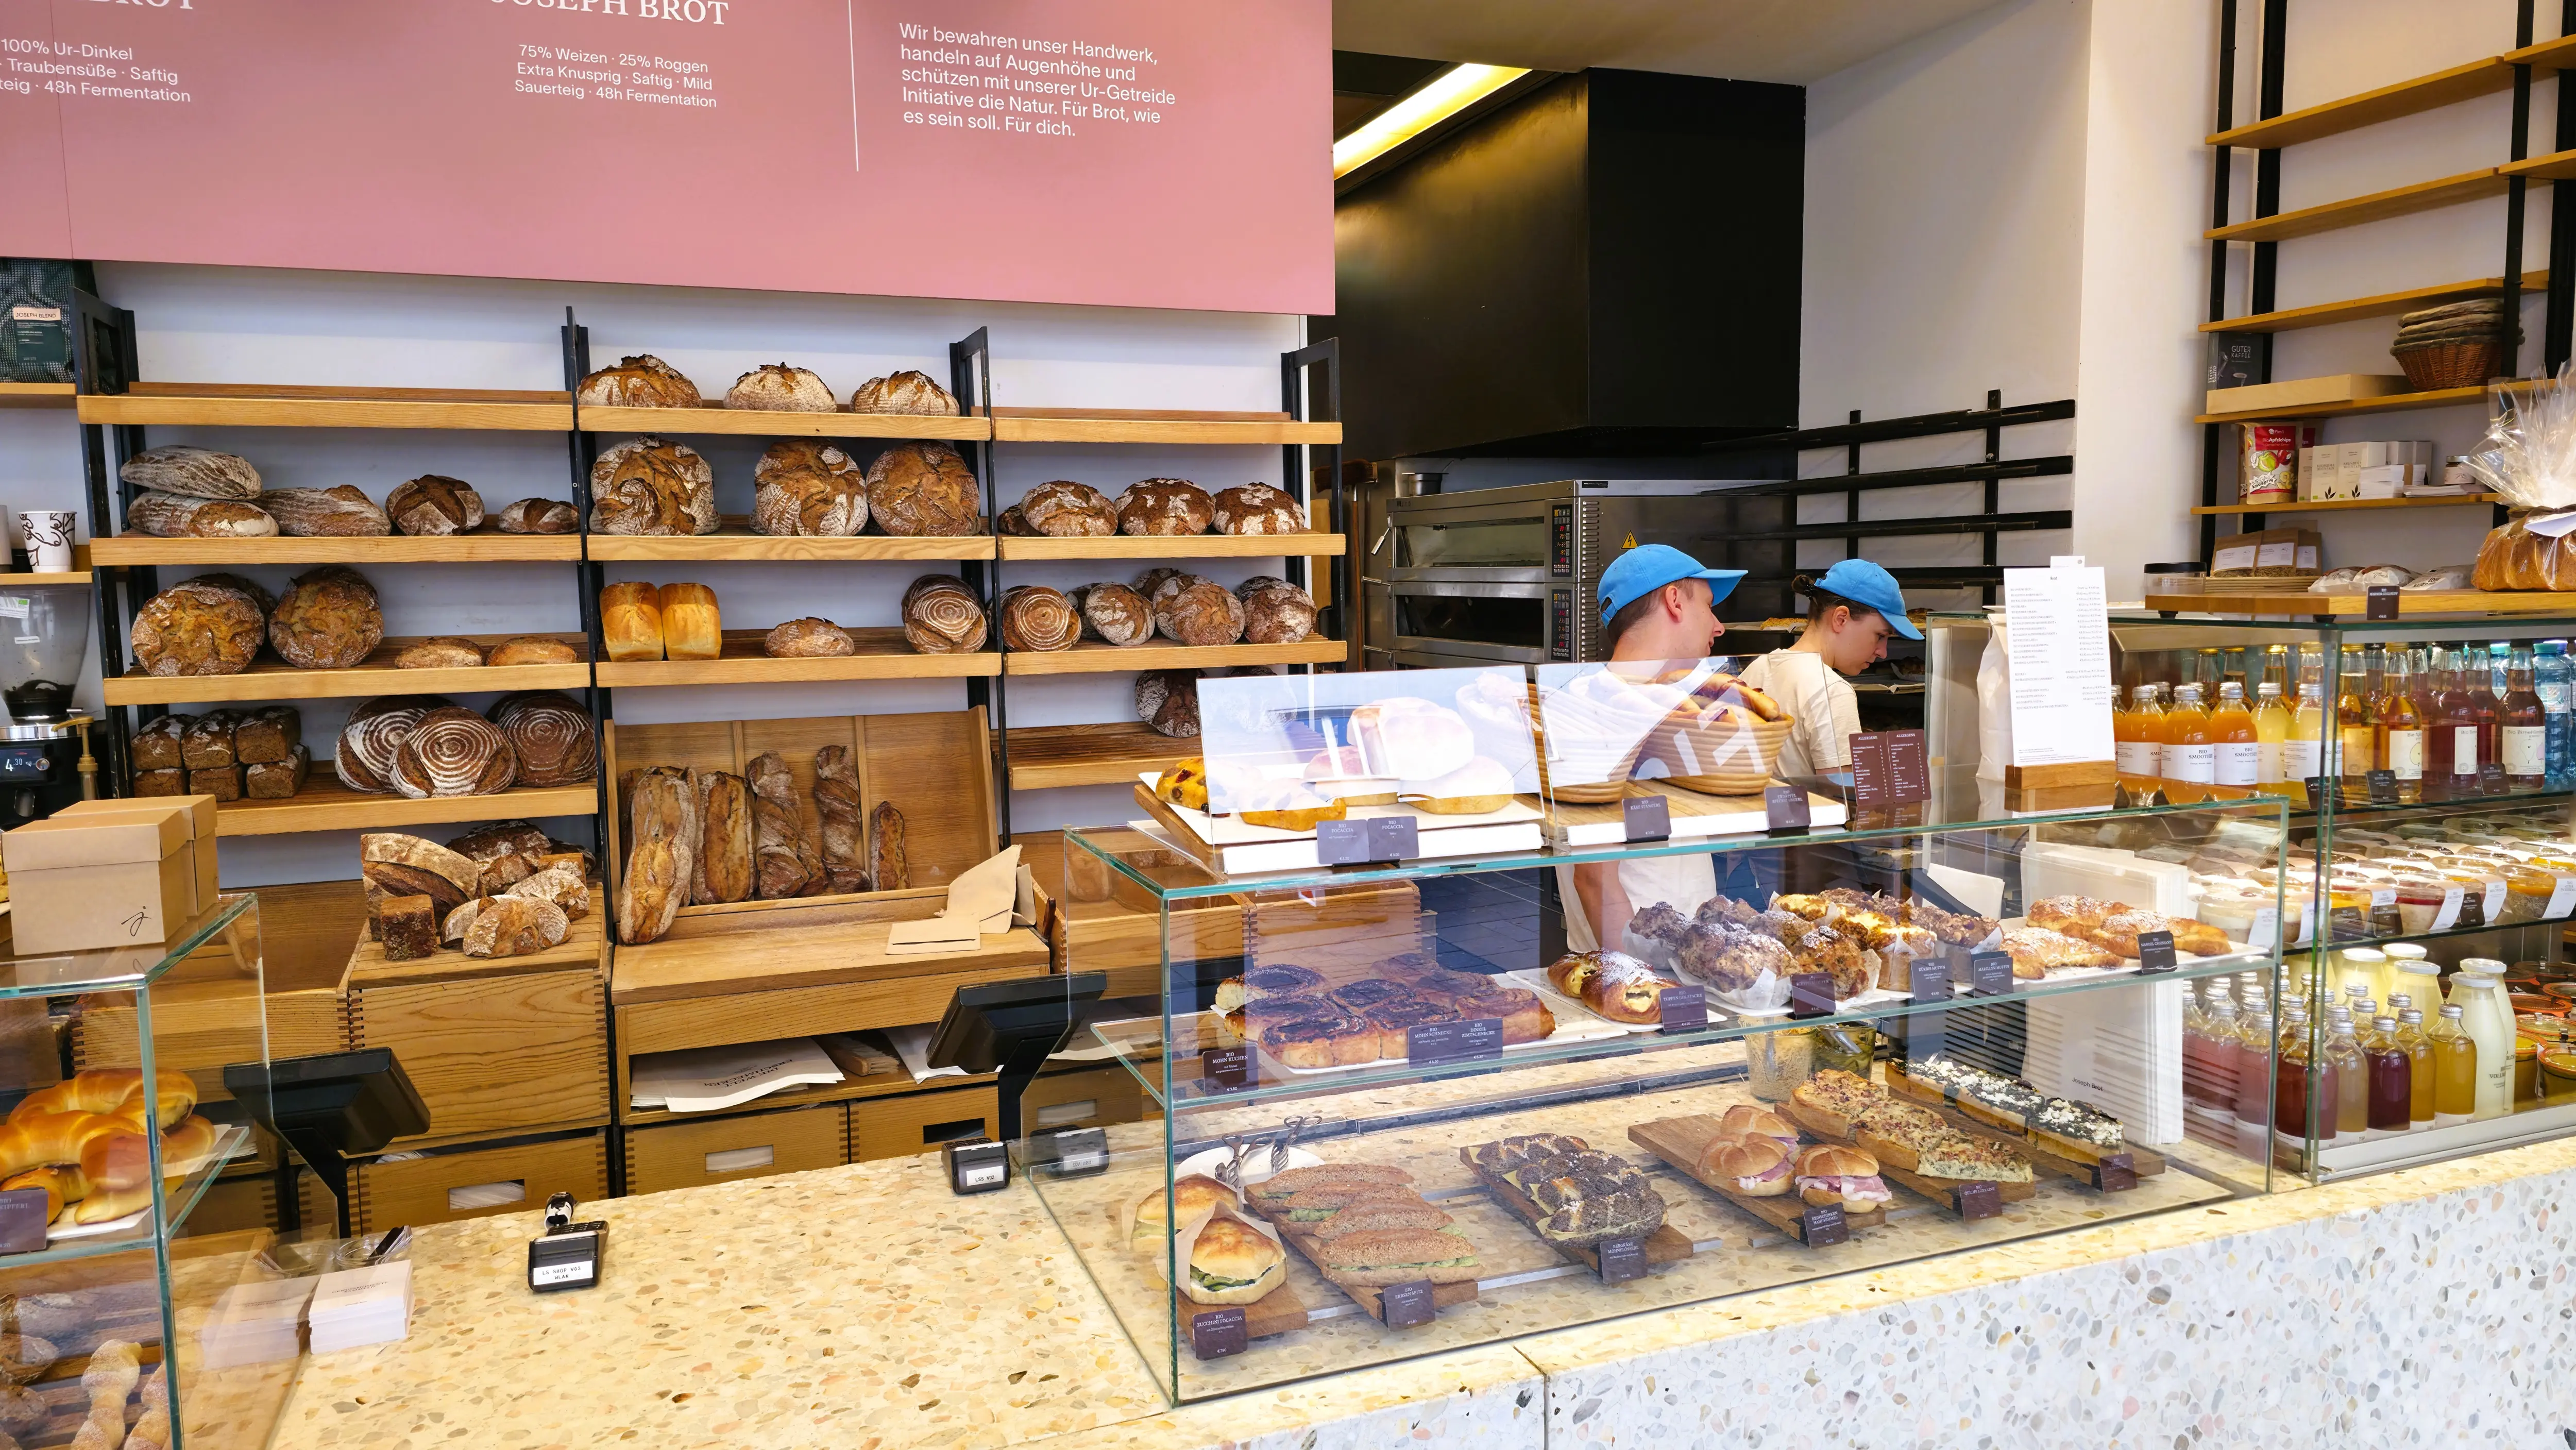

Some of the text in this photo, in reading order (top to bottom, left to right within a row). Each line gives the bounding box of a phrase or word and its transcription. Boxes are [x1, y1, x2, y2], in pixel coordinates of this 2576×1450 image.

[639, 0, 728, 25] BROT
[1, 39, 132, 60] 100% Ur-Dinkel
[900, 23, 1157, 65] Wir bewahren unser Handwerk,
[7, 58, 178, 85] Traubensüße Saftig
[519, 44, 708, 73] 75% Weizen 25% Roggen
[901, 44, 1135, 81] handeln auf Augenhöhe und
[517, 62, 712, 90] Extra Knusprig Saftig Mild
[902, 67, 1175, 105] schützen mit unserer Ur-Getreide
[44, 80, 76, 94] 48h
[81, 82, 191, 102] Fermentation
[515, 80, 717, 108] Sauerteig 48h Fermentation
[903, 87, 1160, 123] Initiative die Natur. Für Brot, wie
[904, 111, 1075, 136] es sein soll. Für dich.
[2252, 478, 2274, 488] knusprig
[704, 1059, 793, 1086] ERSCHMECKEN
[724, 1076, 756, 1088] WELT
[759, 1067, 779, 1076] DIE
[1811, 1211, 1838, 1221] BEINSCHINKEN
[1814, 1216, 1838, 1225] HANDSEMMEL
